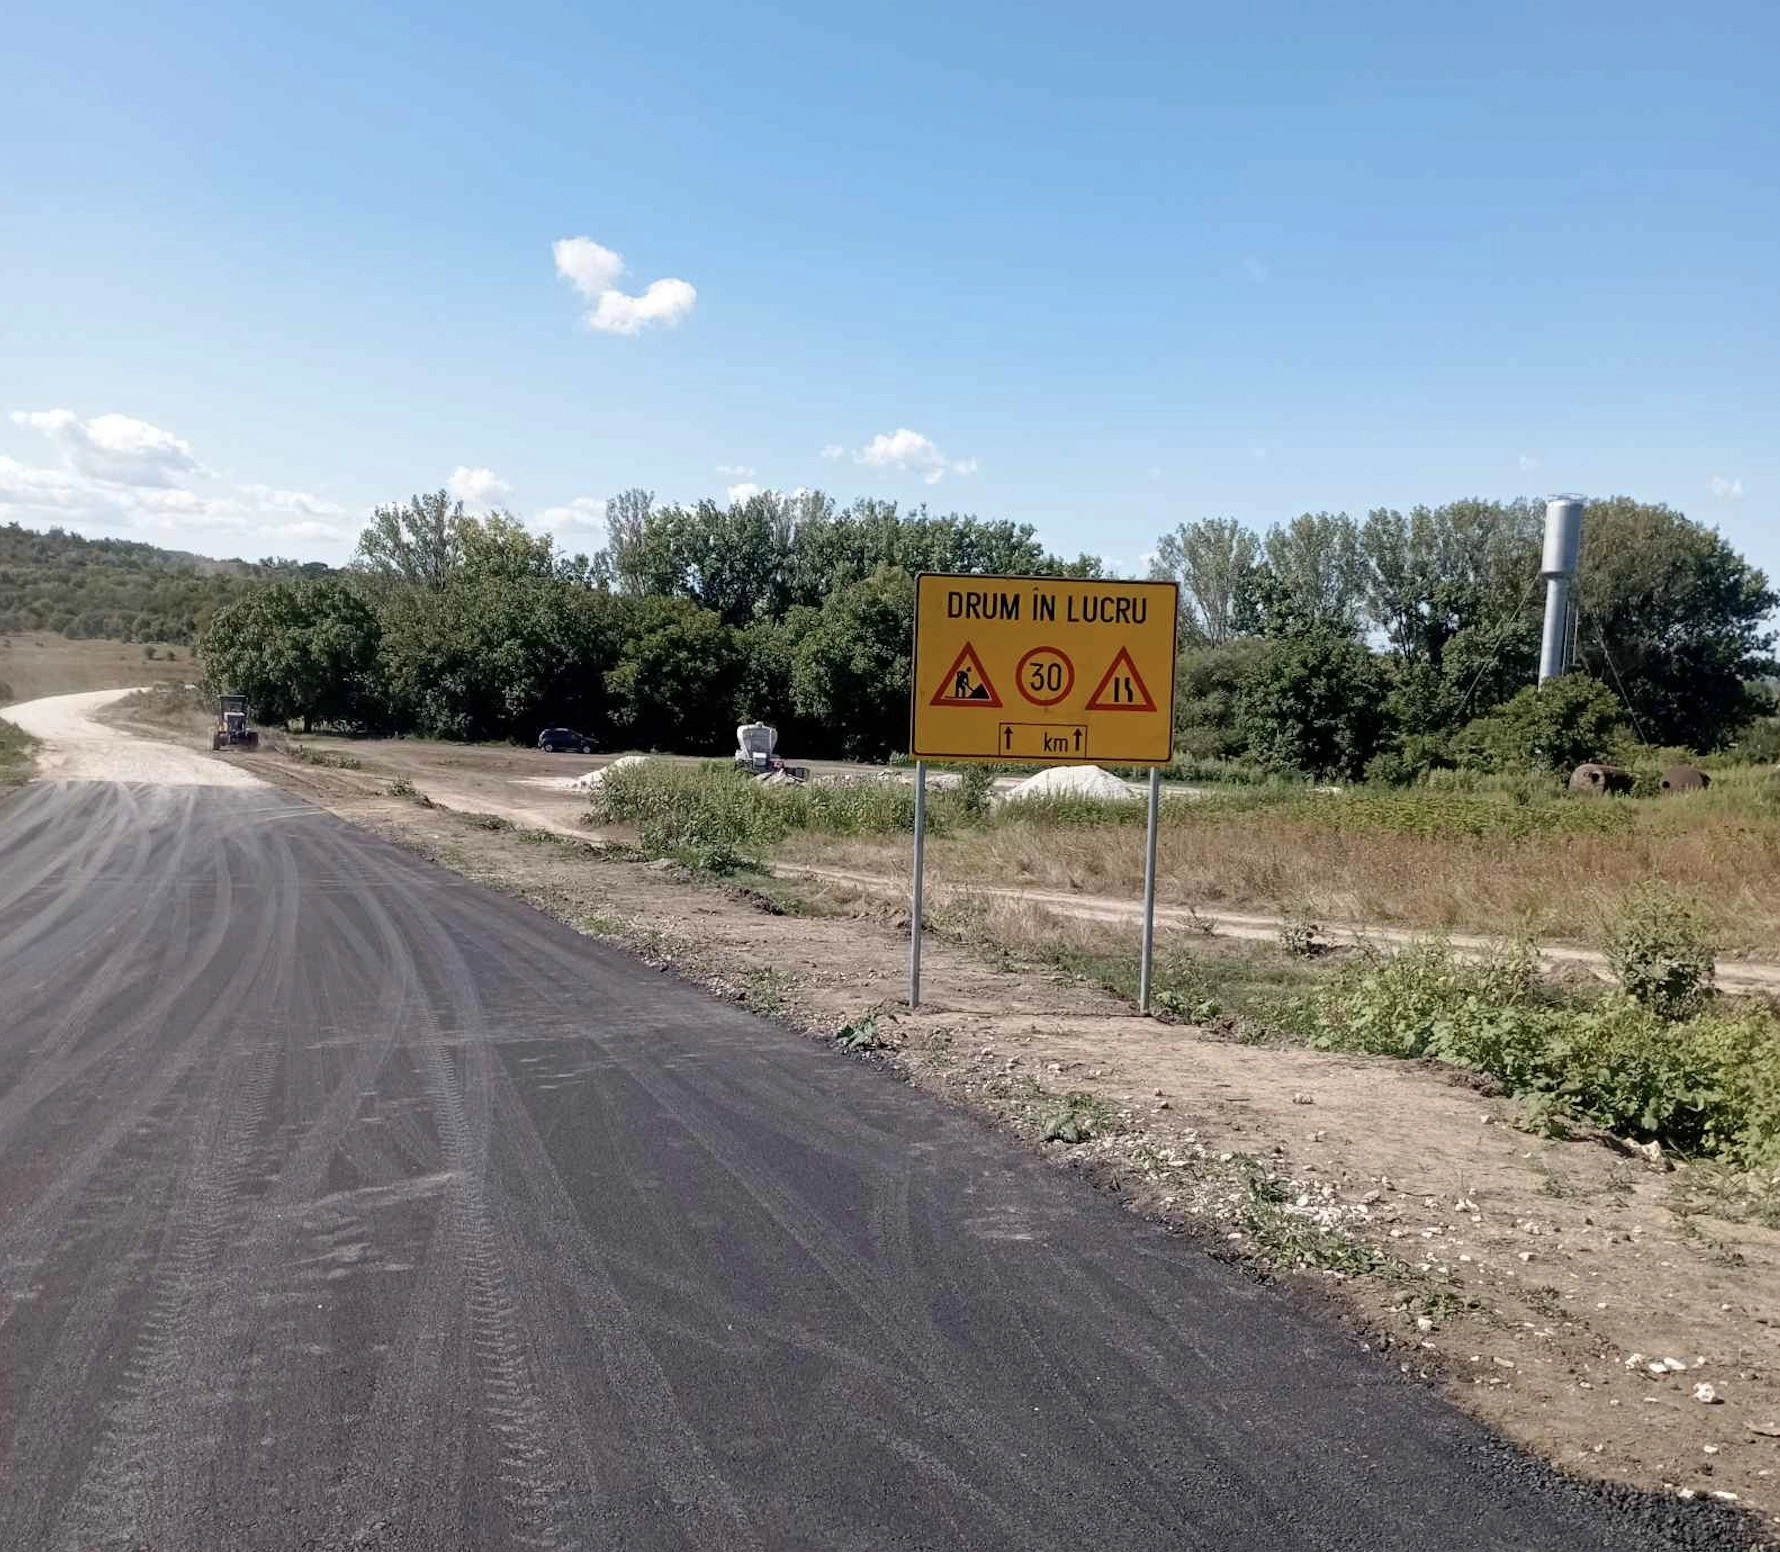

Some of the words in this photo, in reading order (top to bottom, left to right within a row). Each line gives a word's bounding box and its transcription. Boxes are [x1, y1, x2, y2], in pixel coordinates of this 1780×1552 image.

[947, 591, 1020, 621] DRUM
[1032, 587, 1056, 621] ÎN
[1067, 595, 1147, 624] LUCRU
[1029, 662, 1062, 692] 30
[1044, 732, 1068, 753] km
